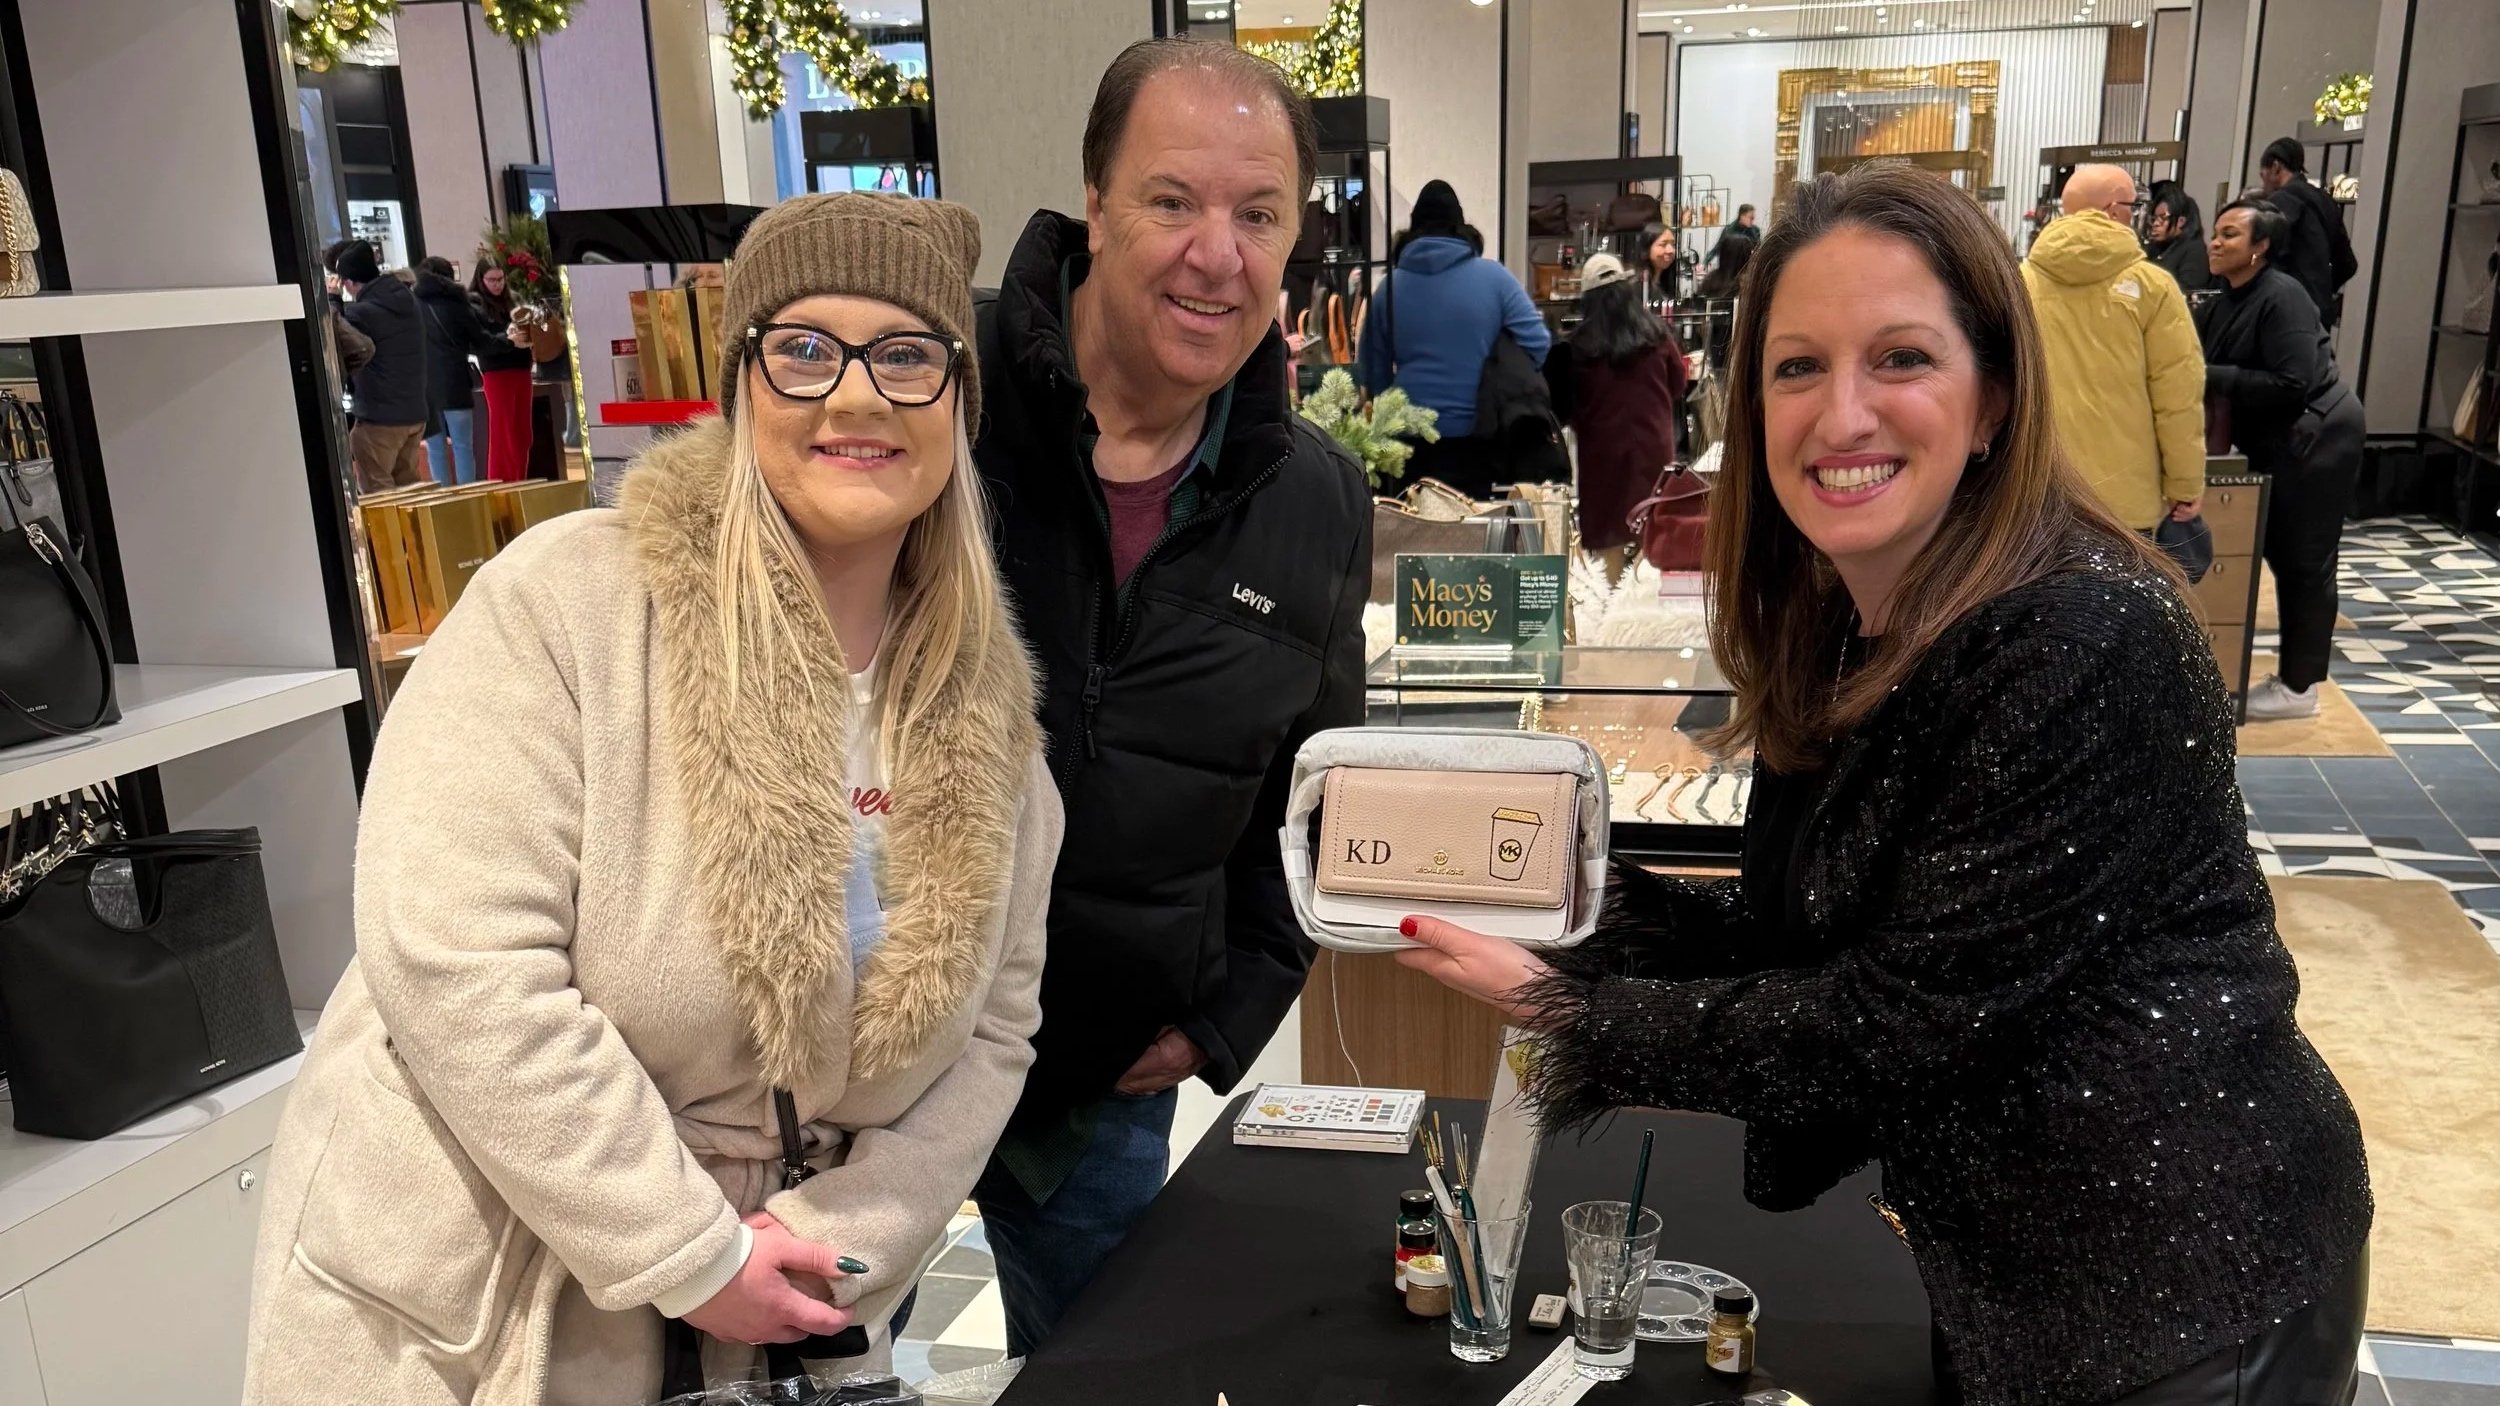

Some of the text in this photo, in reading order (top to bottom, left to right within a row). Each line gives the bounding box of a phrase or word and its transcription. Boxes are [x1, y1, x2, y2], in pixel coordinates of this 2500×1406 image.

[2210, 475, 2264, 485] COACH
[1232, 582, 1272, 615] Levi's
[1411, 576, 1493, 607] Macy's
[1411, 603, 1498, 633] Money
[1344, 838, 1391, 865] KD
